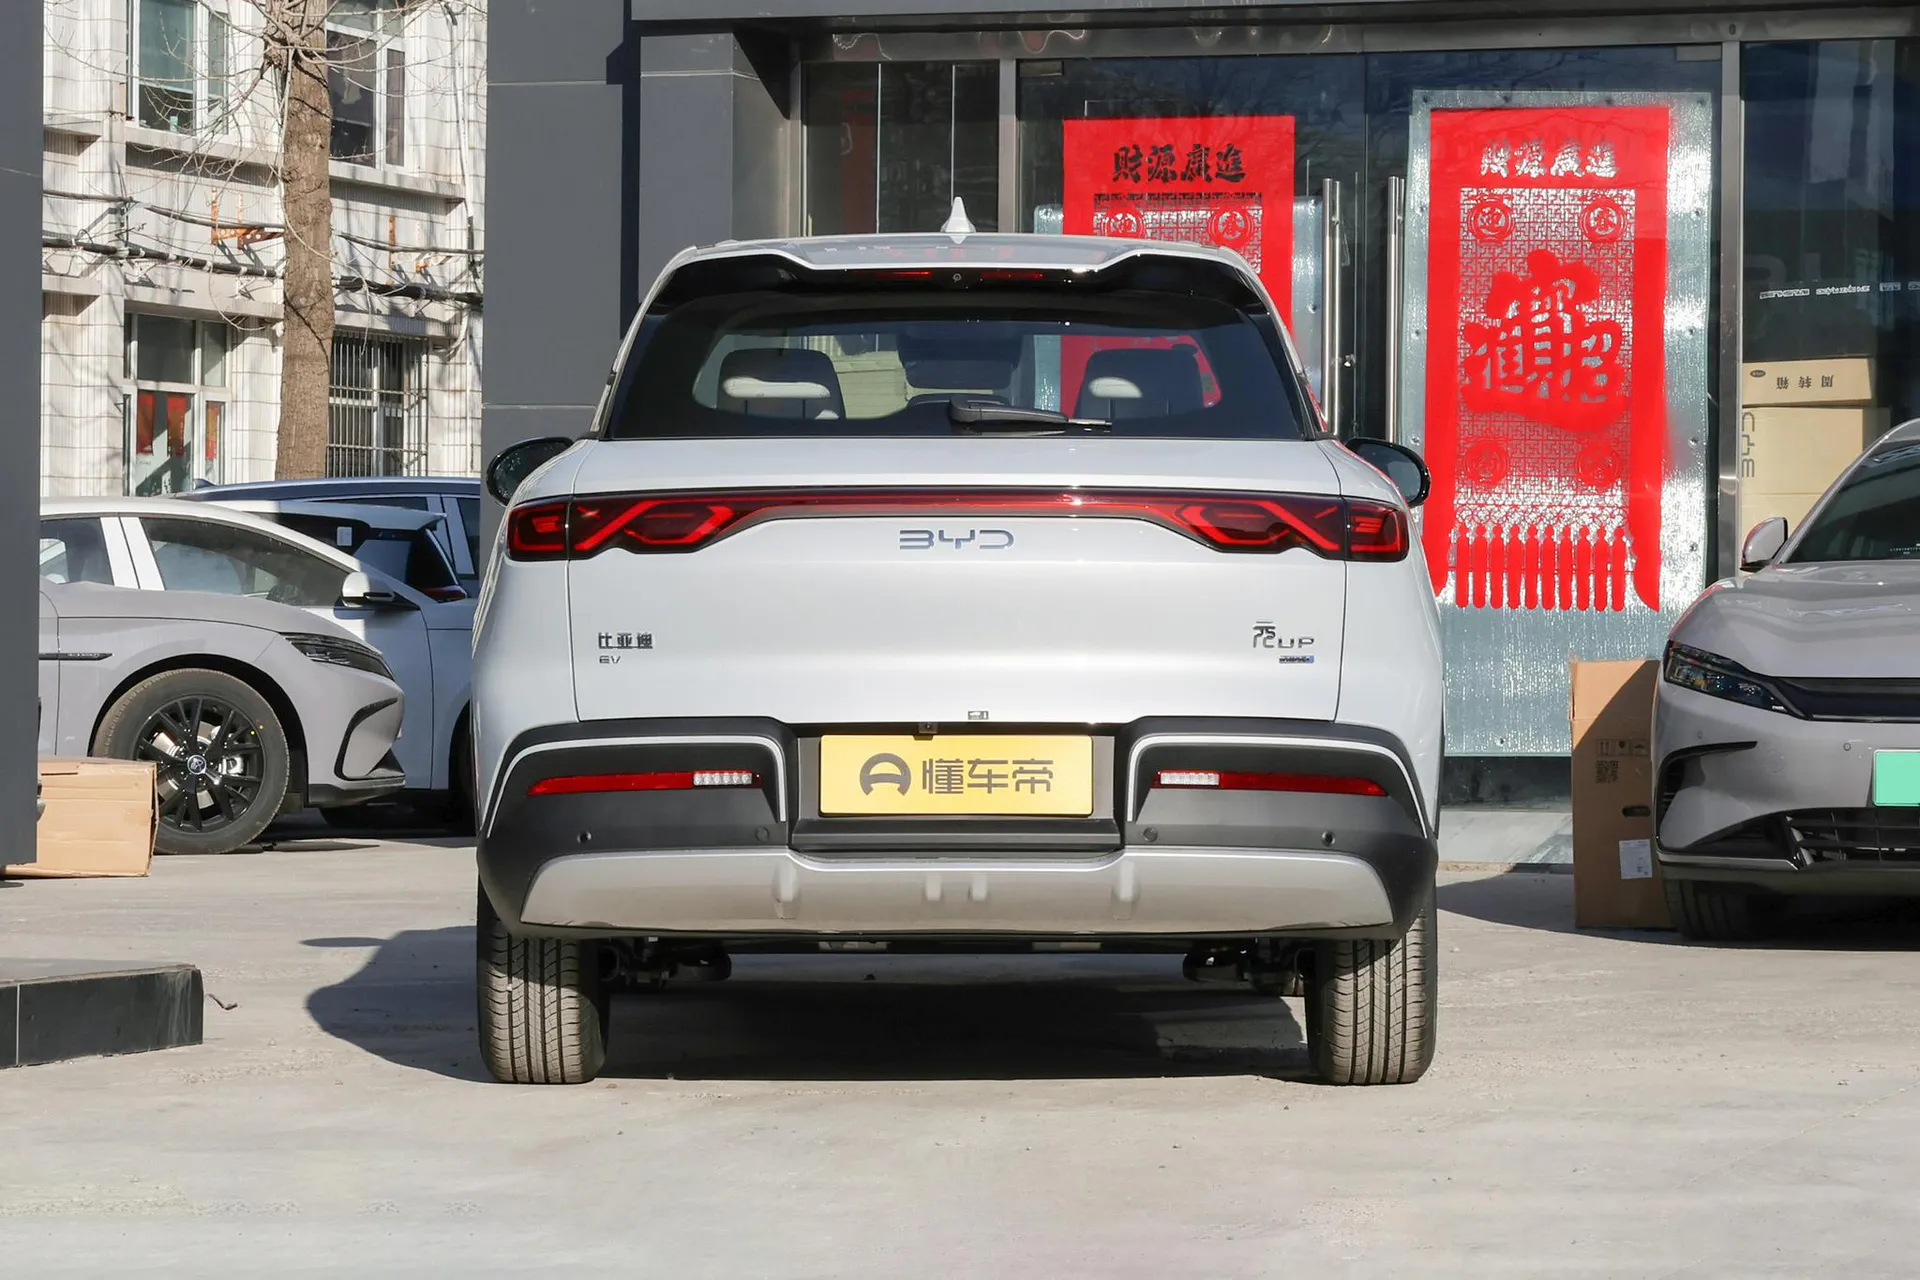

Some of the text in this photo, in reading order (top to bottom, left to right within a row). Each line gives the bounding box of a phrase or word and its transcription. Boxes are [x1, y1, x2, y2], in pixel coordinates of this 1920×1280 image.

[1112, 143, 1247, 184] 財源廣進
[1741, 411, 1755, 478] BYD
[899, 529, 1015, 550] BYD
[598, 632, 653, 650] 比亚迪
[599, 655, 621, 664] EV
[921, 757, 1054, 795] 懂车帝
